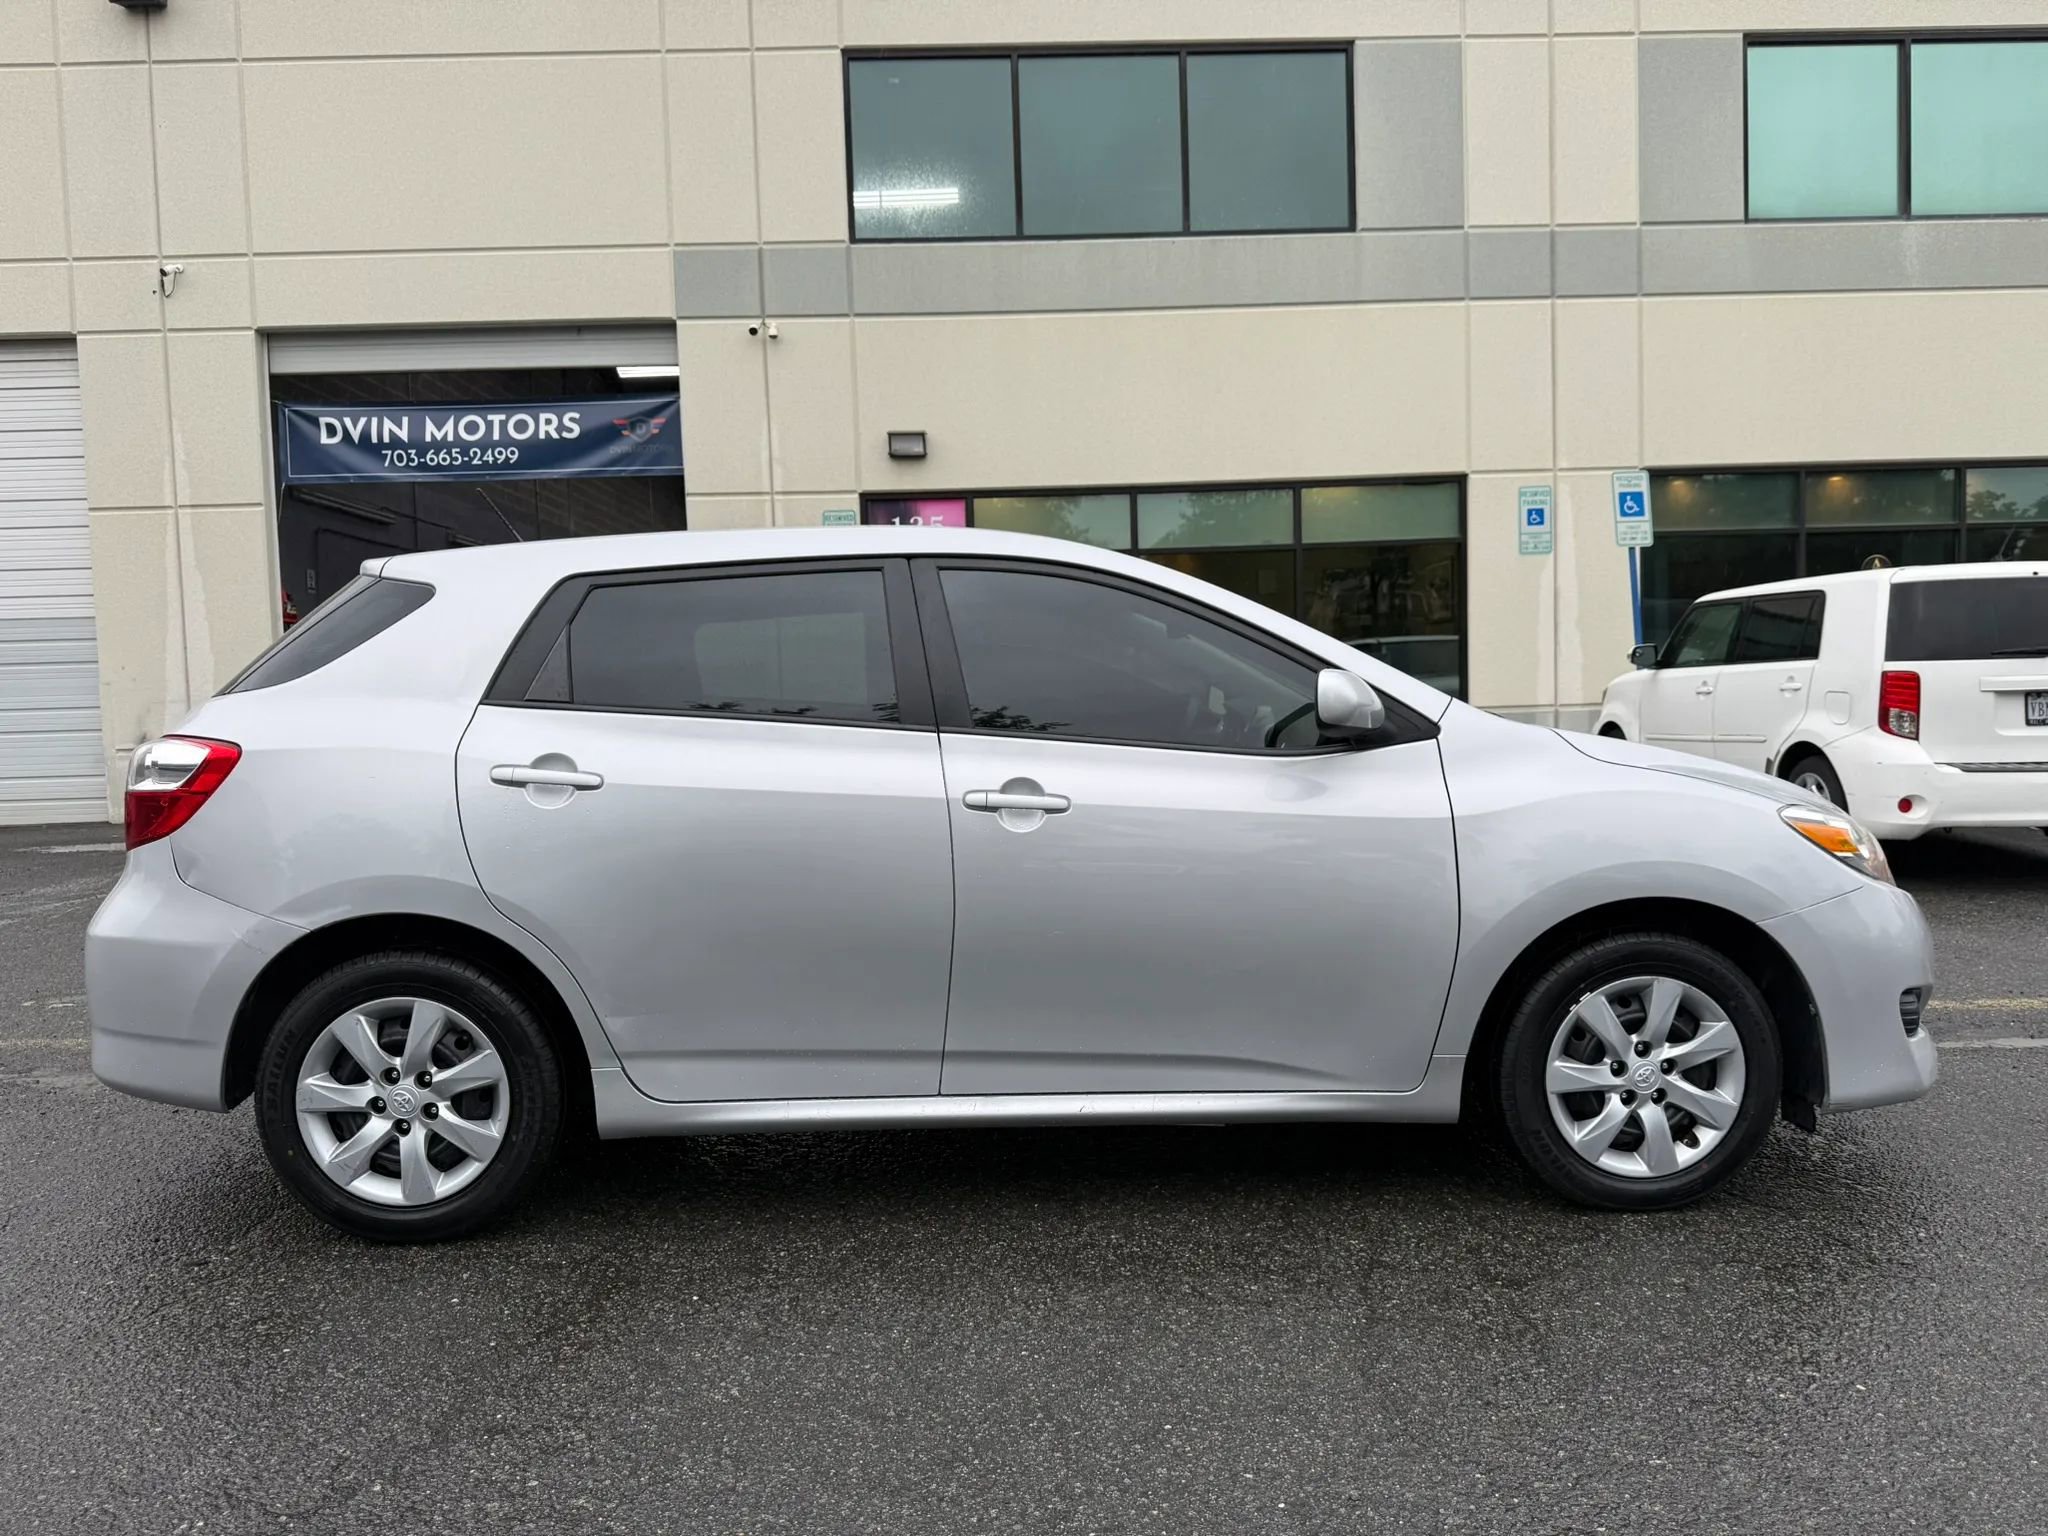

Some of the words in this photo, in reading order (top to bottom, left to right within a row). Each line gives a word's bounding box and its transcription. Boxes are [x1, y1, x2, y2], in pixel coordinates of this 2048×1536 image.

[319, 415, 409, 445] DVIN
[425, 412, 581, 443] MOTORS
[382, 447, 519, 467] 703-665-2499
